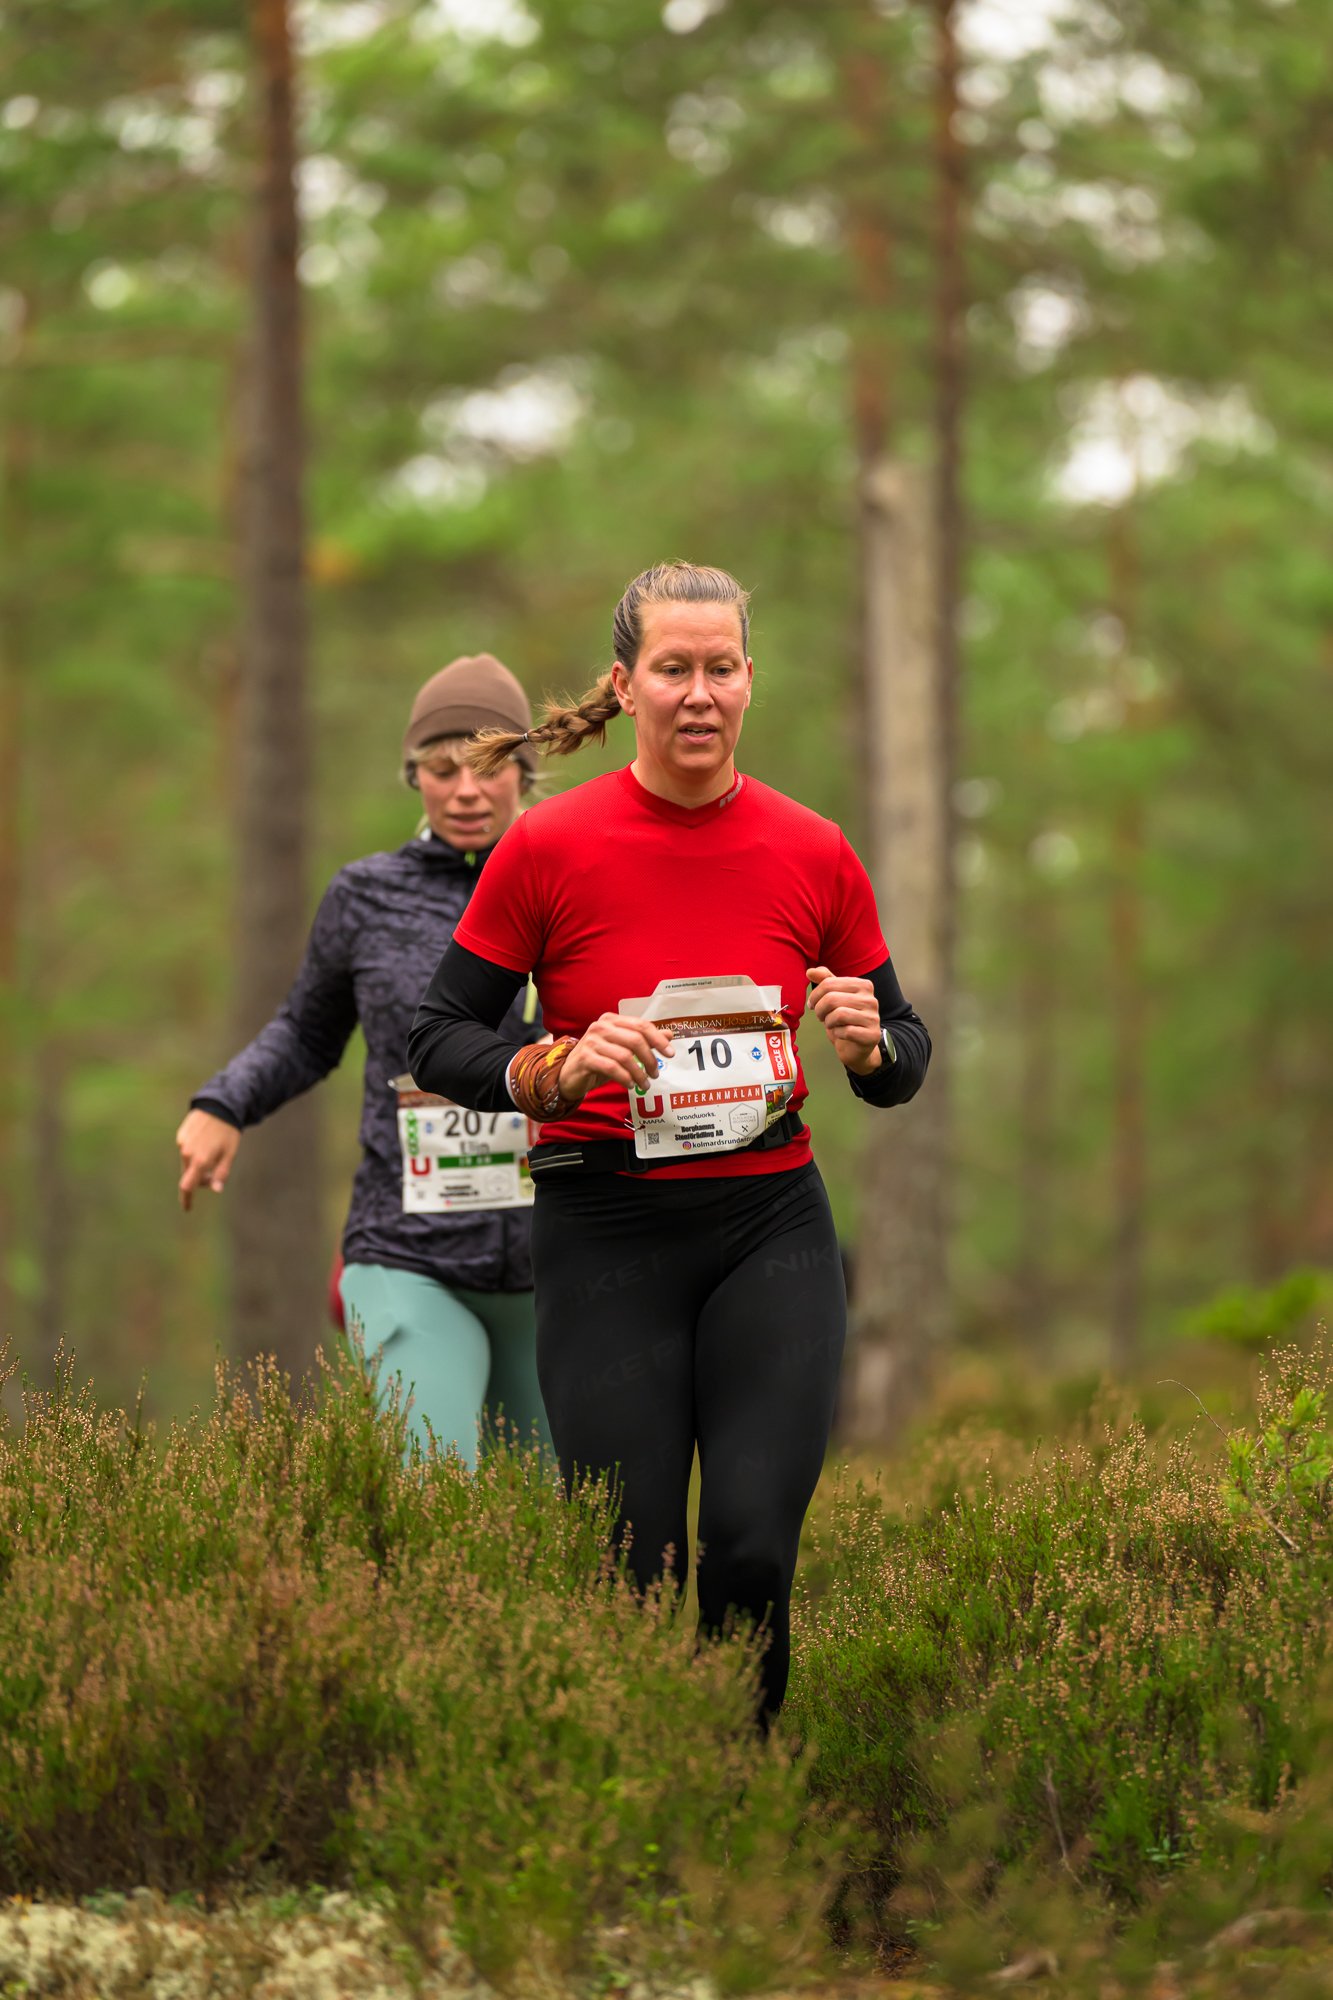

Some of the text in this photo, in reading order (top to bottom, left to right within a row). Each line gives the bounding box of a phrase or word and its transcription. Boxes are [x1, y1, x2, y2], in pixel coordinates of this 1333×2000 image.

[688, 1037, 733, 1072] 10
[774, 1049, 786, 1077] CIRCLE
[672, 1087, 761, 1106] EFTERANMÄLAN
[444, 1110, 499, 1137] 207
